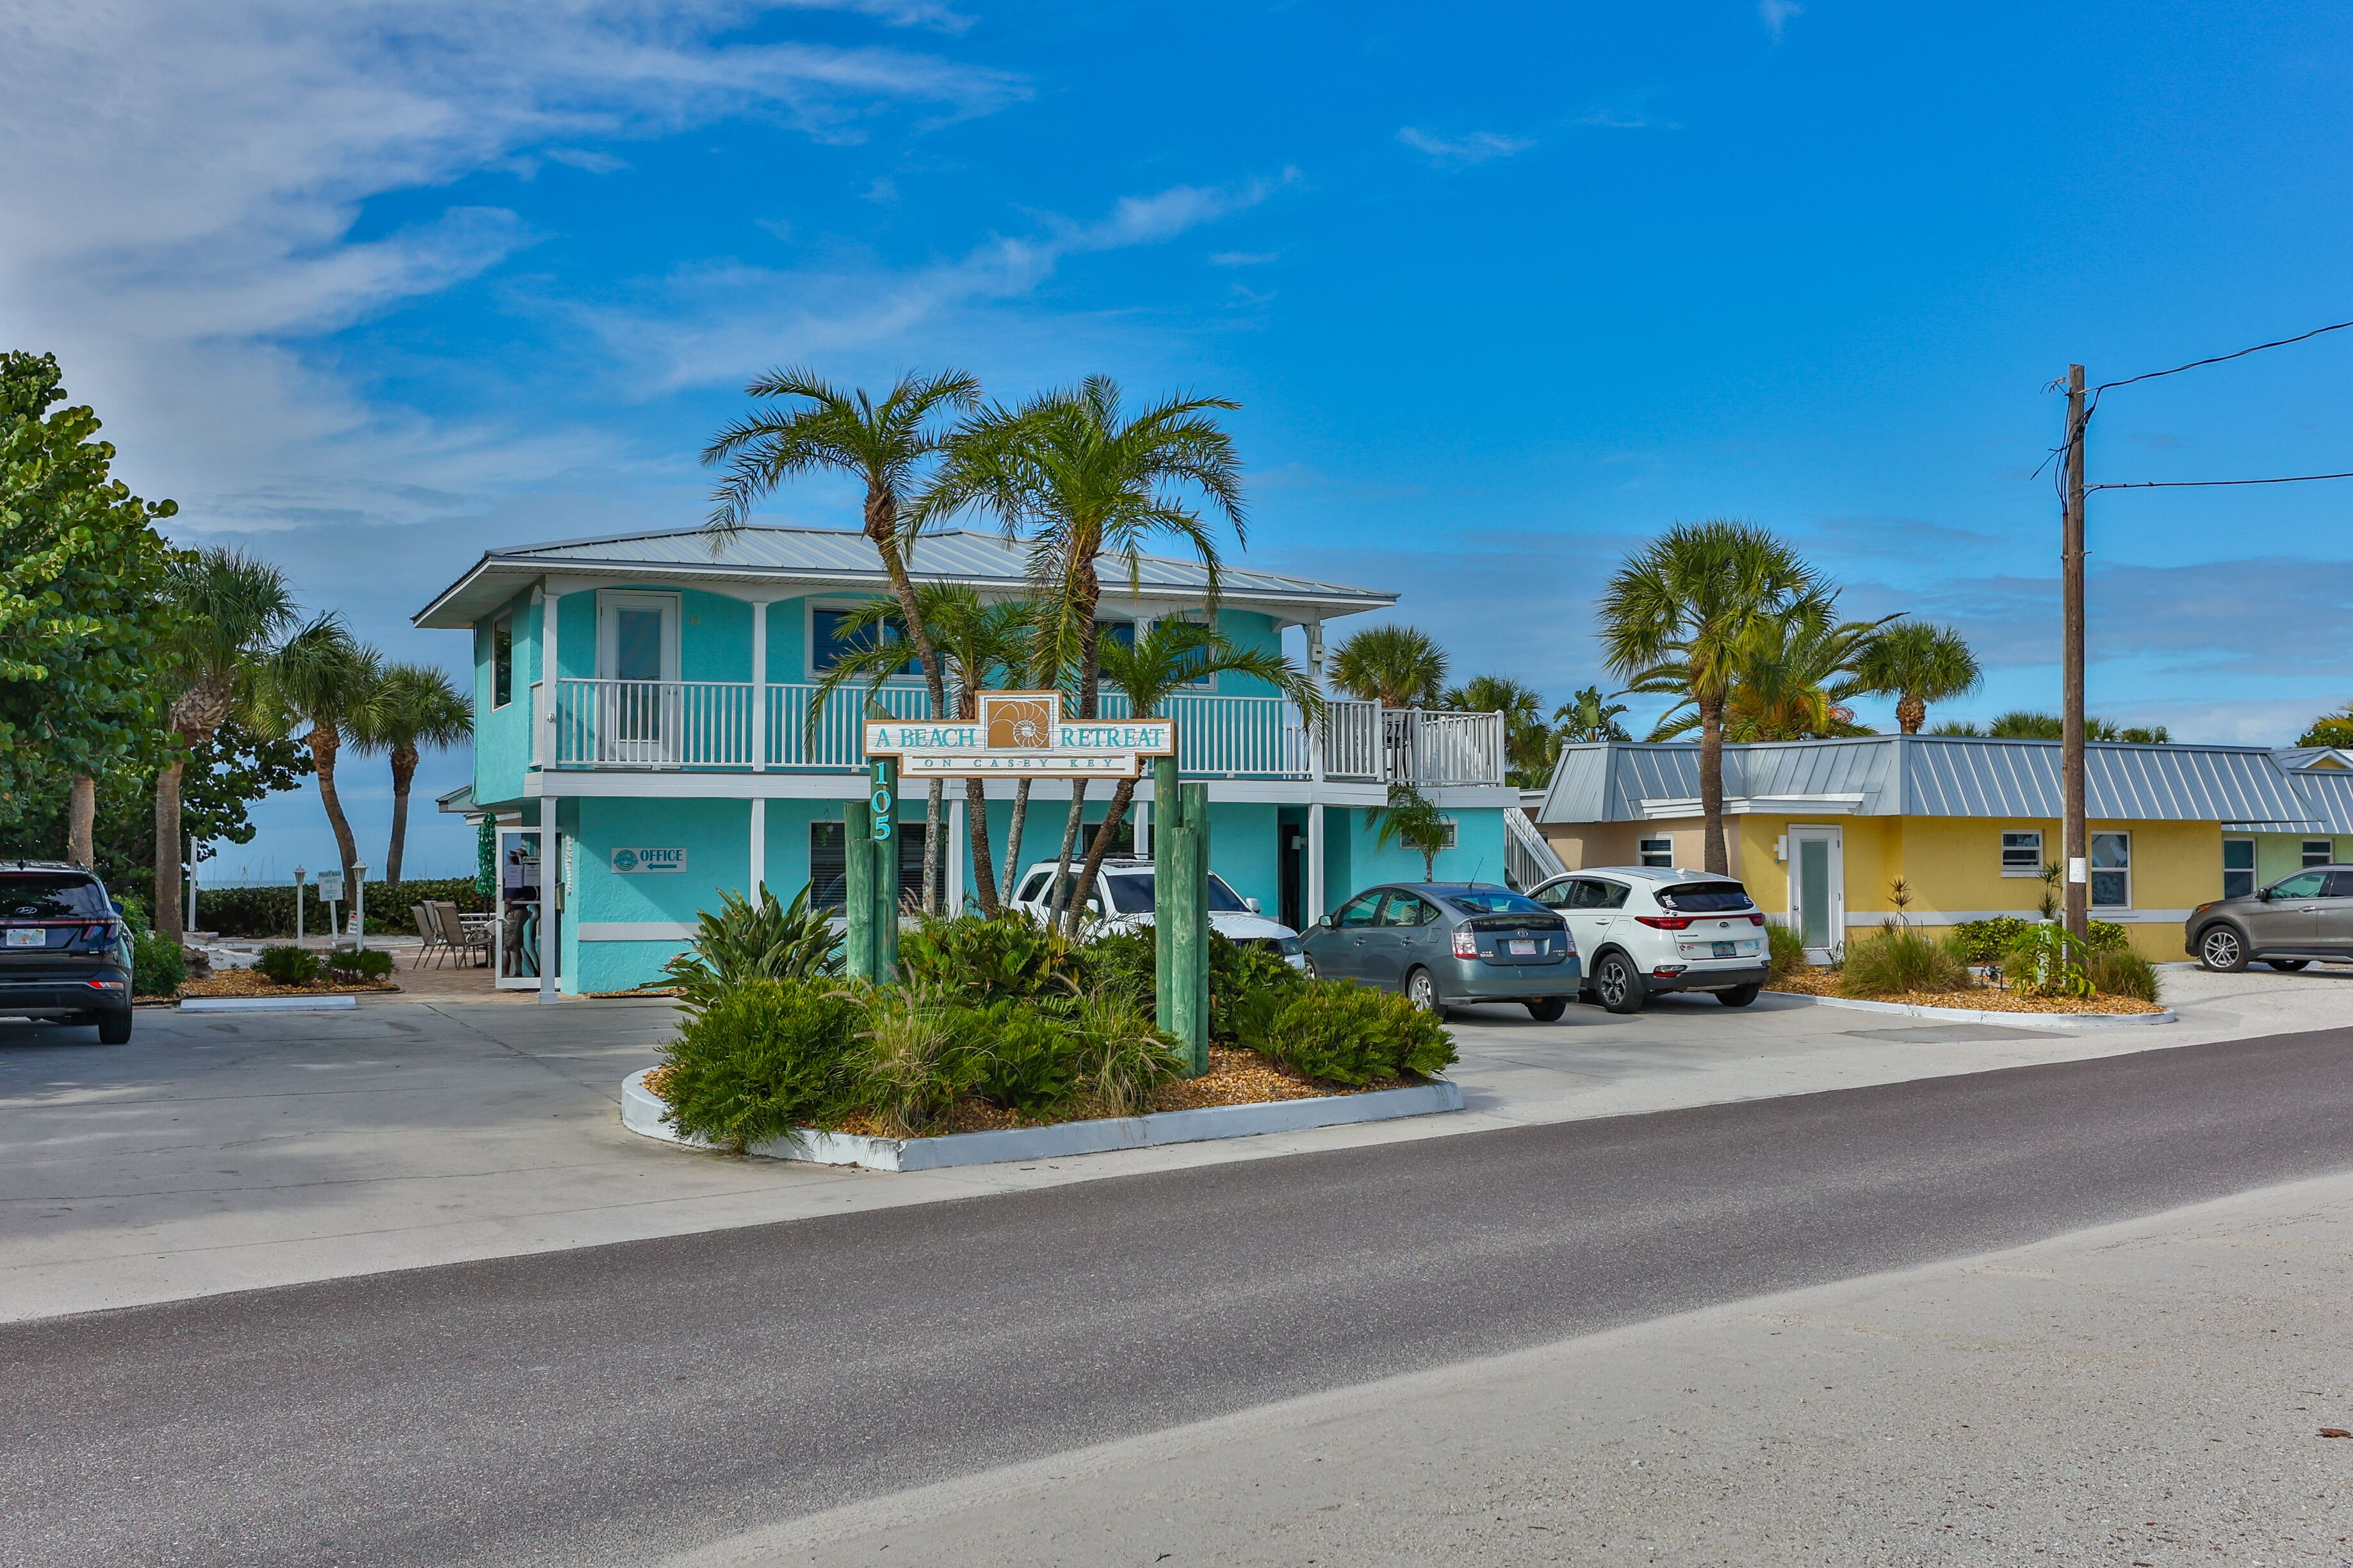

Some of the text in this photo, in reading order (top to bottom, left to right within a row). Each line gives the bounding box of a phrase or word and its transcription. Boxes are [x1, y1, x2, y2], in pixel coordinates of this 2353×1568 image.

[687, 615, 699, 626] 12
[874, 727, 1164, 747] A BEACH RETREAT
[924, 759, 1112, 767] ON CASEY KEY
[872, 761, 892, 841] 105
[640, 849, 683, 861] OFFICE
